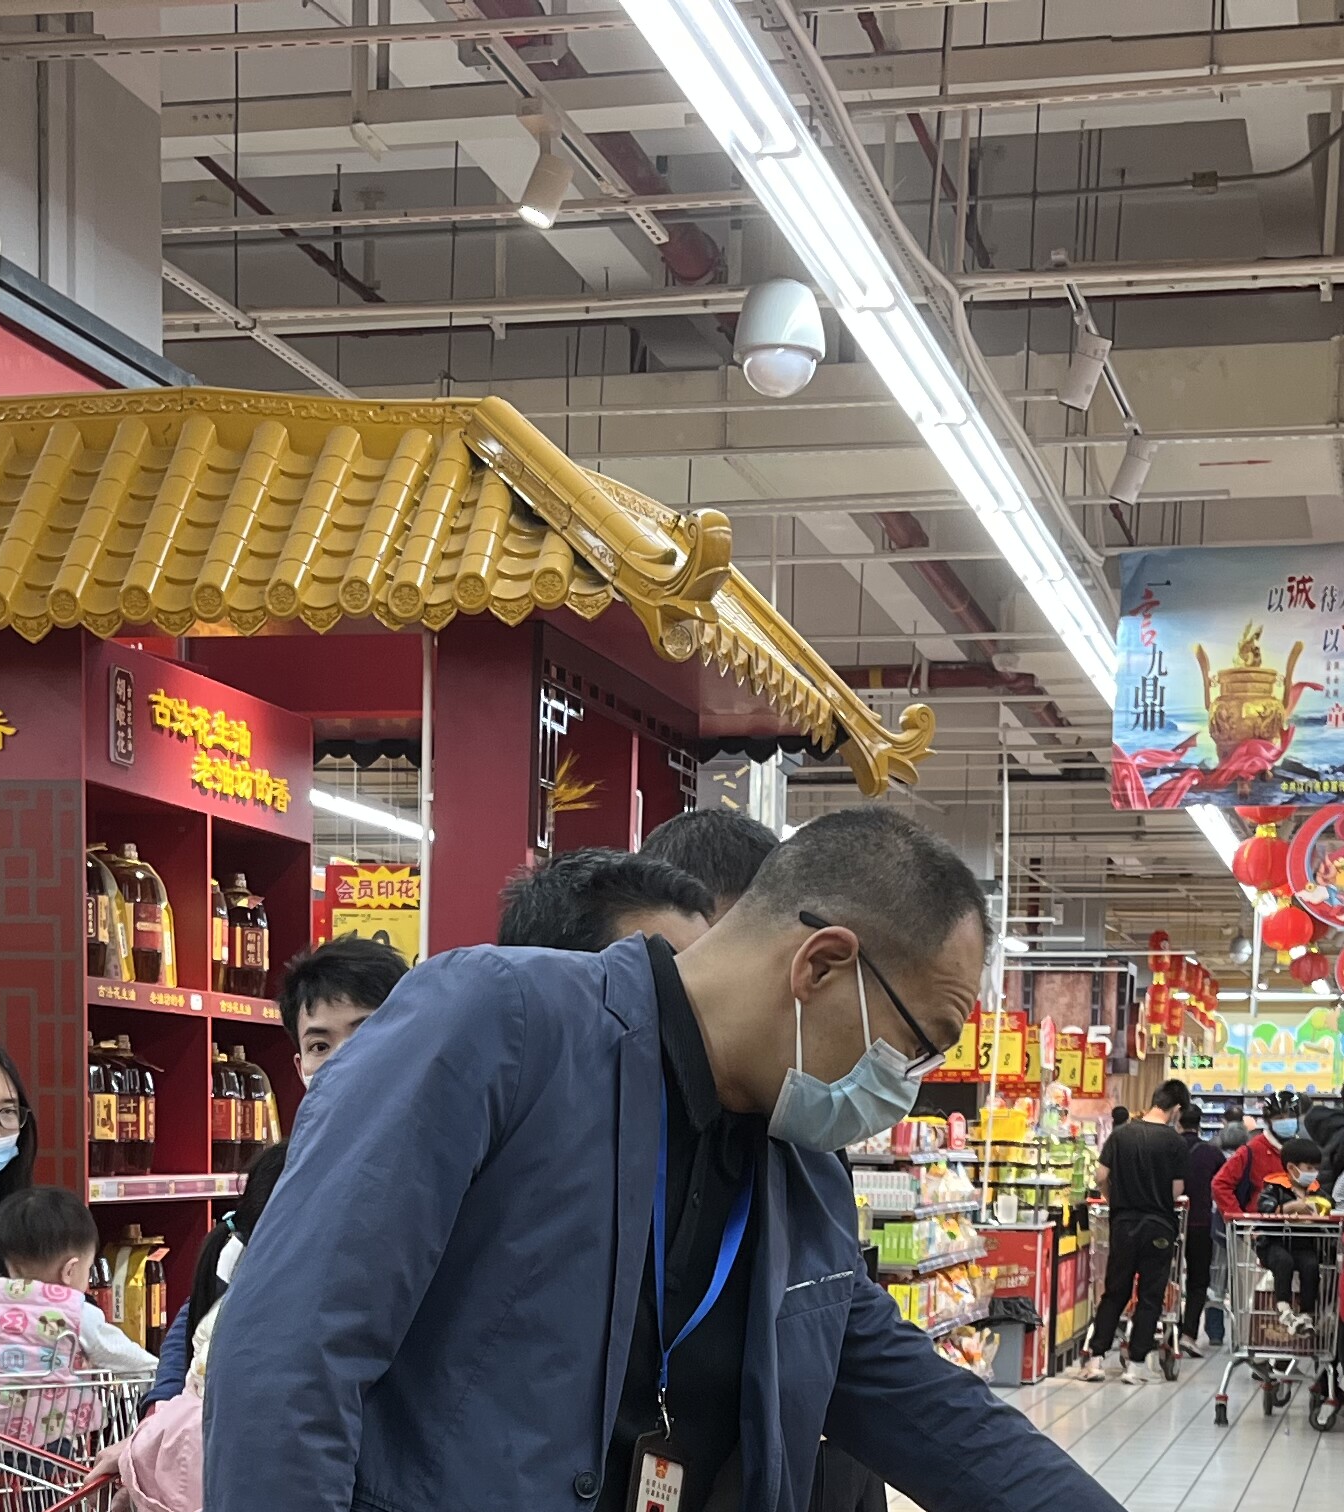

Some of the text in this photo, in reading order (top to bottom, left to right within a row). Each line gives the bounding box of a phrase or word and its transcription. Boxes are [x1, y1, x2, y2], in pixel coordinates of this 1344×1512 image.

[1129, 579, 1171, 732] 一言九鼎
[149, 688, 252, 758] 古法花生油
[192, 751, 291, 813] 老油坊的香
[336, 879, 420, 900] 会员印花
